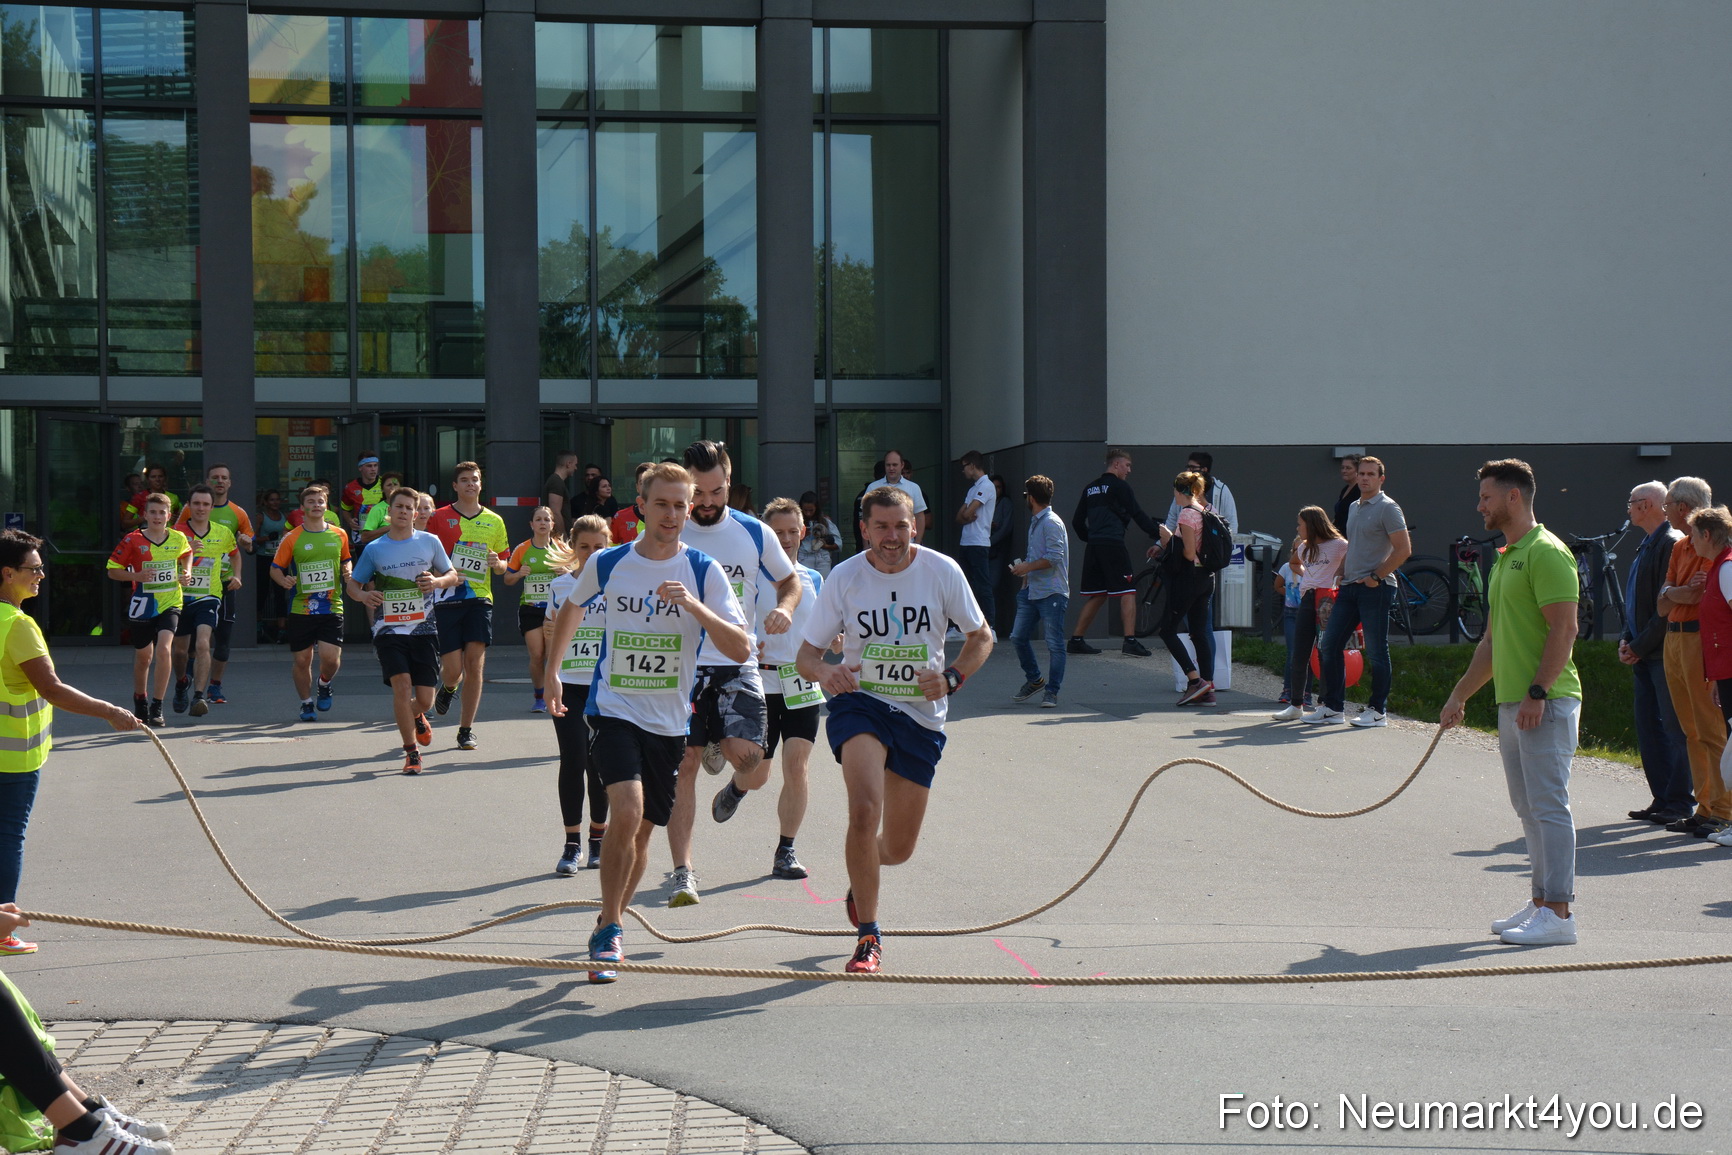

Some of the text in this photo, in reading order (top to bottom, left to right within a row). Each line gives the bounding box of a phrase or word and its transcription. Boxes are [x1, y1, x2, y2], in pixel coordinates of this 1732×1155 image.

[174, 441, 203, 449] CASTIN
[289, 446, 315, 454] REWE
[295, 468, 311, 478] dm
[457, 547, 486, 558] BOCK
[303, 563, 329, 571] BOCK
[460, 557, 481, 571] 178
[308, 571, 328, 582] 122
[310, 582, 328, 590] JONAS
[387, 591, 418, 599] BOCK
[392, 602, 416, 613] 524
[617, 594, 680, 619] SUSPA
[857, 600, 931, 641] SUSPA
[575, 629, 605, 638] OCK
[618, 635, 673, 648] BOCK
[572, 643, 600, 657] 141
[868, 646, 922, 659] BOCK
[571, 660, 597, 668] BIANC
[626, 654, 666, 673] 142
[875, 664, 915, 682] 140
[620, 677, 668, 687] DOMINIK
[871, 685, 915, 695] JOHANN
